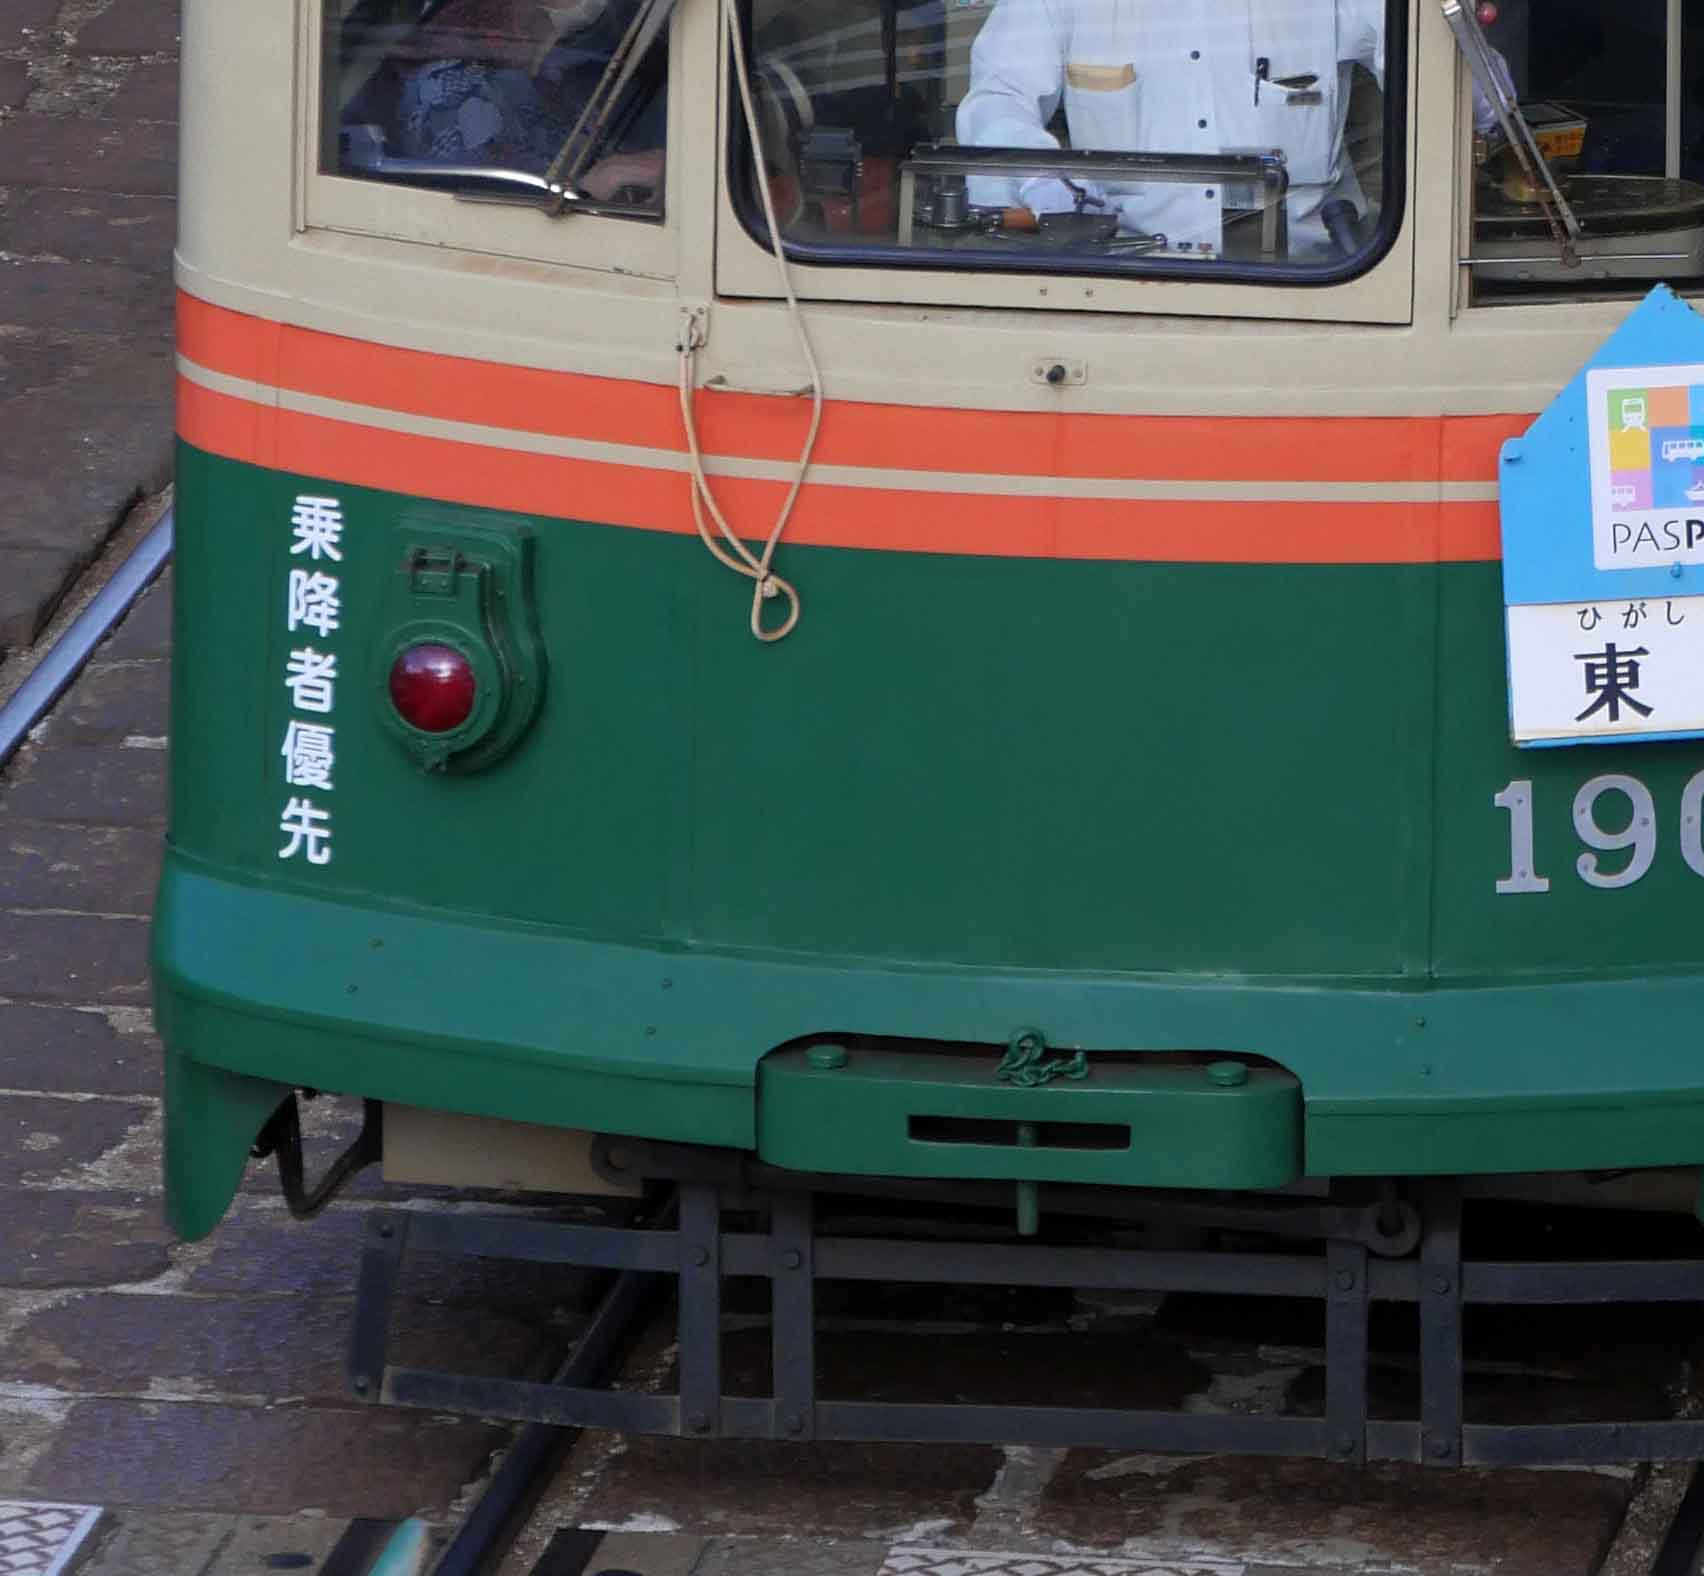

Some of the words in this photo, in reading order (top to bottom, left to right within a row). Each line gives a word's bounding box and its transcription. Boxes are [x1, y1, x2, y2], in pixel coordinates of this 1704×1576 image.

[278, 494, 343, 865] 乗降者優先
